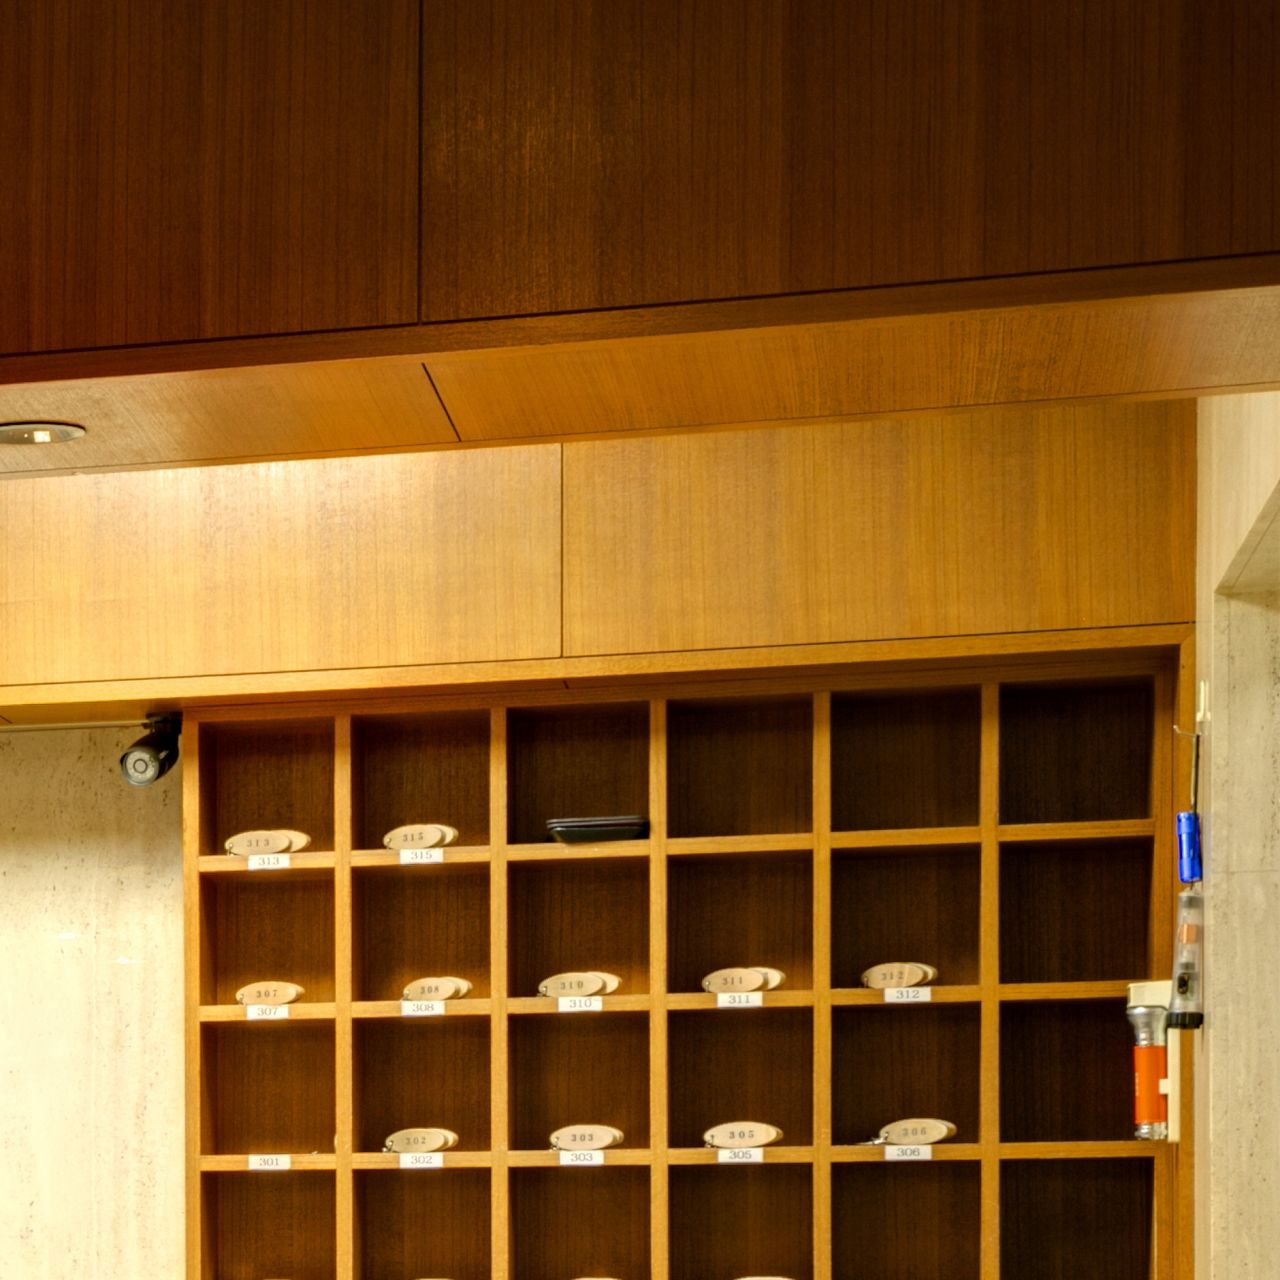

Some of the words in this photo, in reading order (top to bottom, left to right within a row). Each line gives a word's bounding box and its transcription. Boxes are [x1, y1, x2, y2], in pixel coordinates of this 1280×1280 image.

[246, 838, 270, 848] 313
[403, 832, 425, 843] 315
[258, 856, 280, 865] 313
[410, 850, 433, 861] 315
[559, 979, 585, 990] 310
[722, 976, 743, 986] 311
[255, 988, 279, 999] 307
[420, 985, 440, 995] 308
[896, 989, 920, 1000] 312
[569, 998, 593, 1009] 310
[728, 994, 751, 1005] 311
[256, 1006, 279, 1017] 307
[412, 1002, 435, 1014] 308
[571, 1133, 595, 1143] 303
[728, 1130, 756, 1140] 305
[405, 1136, 427, 1146] 302
[570, 1152, 593, 1163] 303
[728, 1149, 753, 1161] 305
[896, 1147, 921, 1158] 306
[258, 1157, 281, 1168] 301
[410, 1155, 433, 1166] 302
